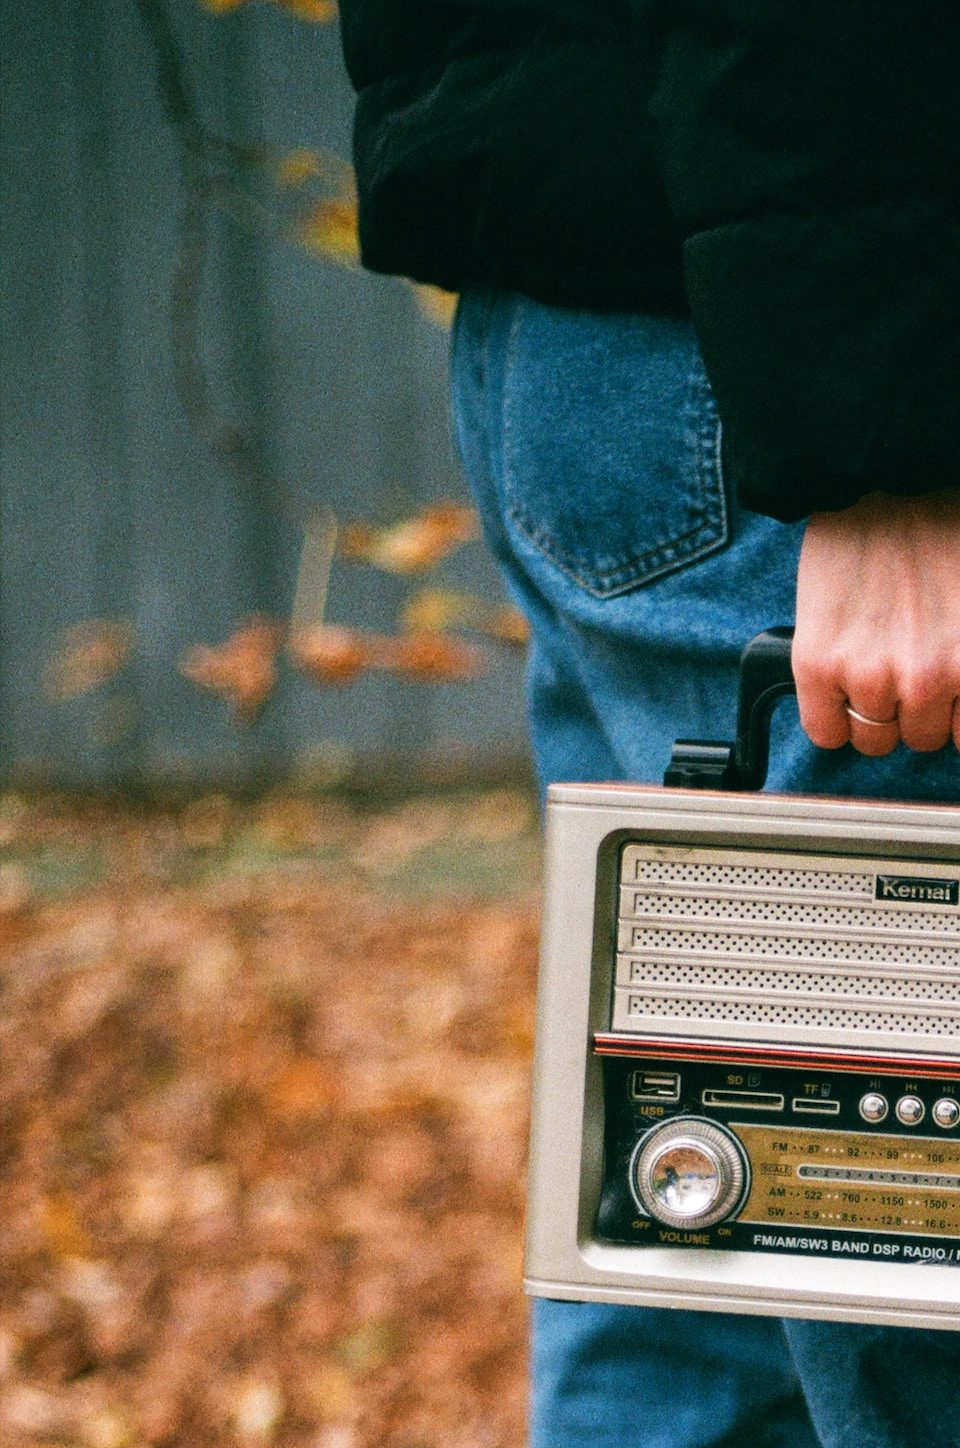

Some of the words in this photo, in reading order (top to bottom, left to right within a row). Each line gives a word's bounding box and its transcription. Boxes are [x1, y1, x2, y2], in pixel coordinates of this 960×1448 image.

[883, 878, 951, 901] Kemai
[727, 1075, 744, 1086] SD
[803, 1083, 819, 1094] TF
[640, 1106, 665, 1116] USB
[772, 1142, 788, 1152] FM
[807, 1144, 820, 1154] 87
[847, 1148, 860, 1158] 92
[885, 1150, 900, 1160] 99
[927, 1153, 945, 1163] 106
[761, 1164, 790, 1174] SCALE
[769, 1187, 786, 1197] AM
[804, 1191, 823, 1201] 522
[842, 1193, 860, 1203] 760
[882, 1196, 904, 1206] 1150
[924, 1199, 948, 1209] 1500
[767, 1207, 785, 1217] SW
[804, 1210, 820, 1220] 5.9
[842, 1213, 858, 1223] 8.6
[632, 1220, 651, 1230] OFF
[660, 1230, 711, 1245] VOLUME
[718, 1227, 733, 1237] ON
[753, 1235, 828, 1250] FM/AM/SW3
[832, 1240, 870, 1254] BAND
[873, 1243, 900, 1256] DSP
[904, 1246, 946, 1260] RADIO
